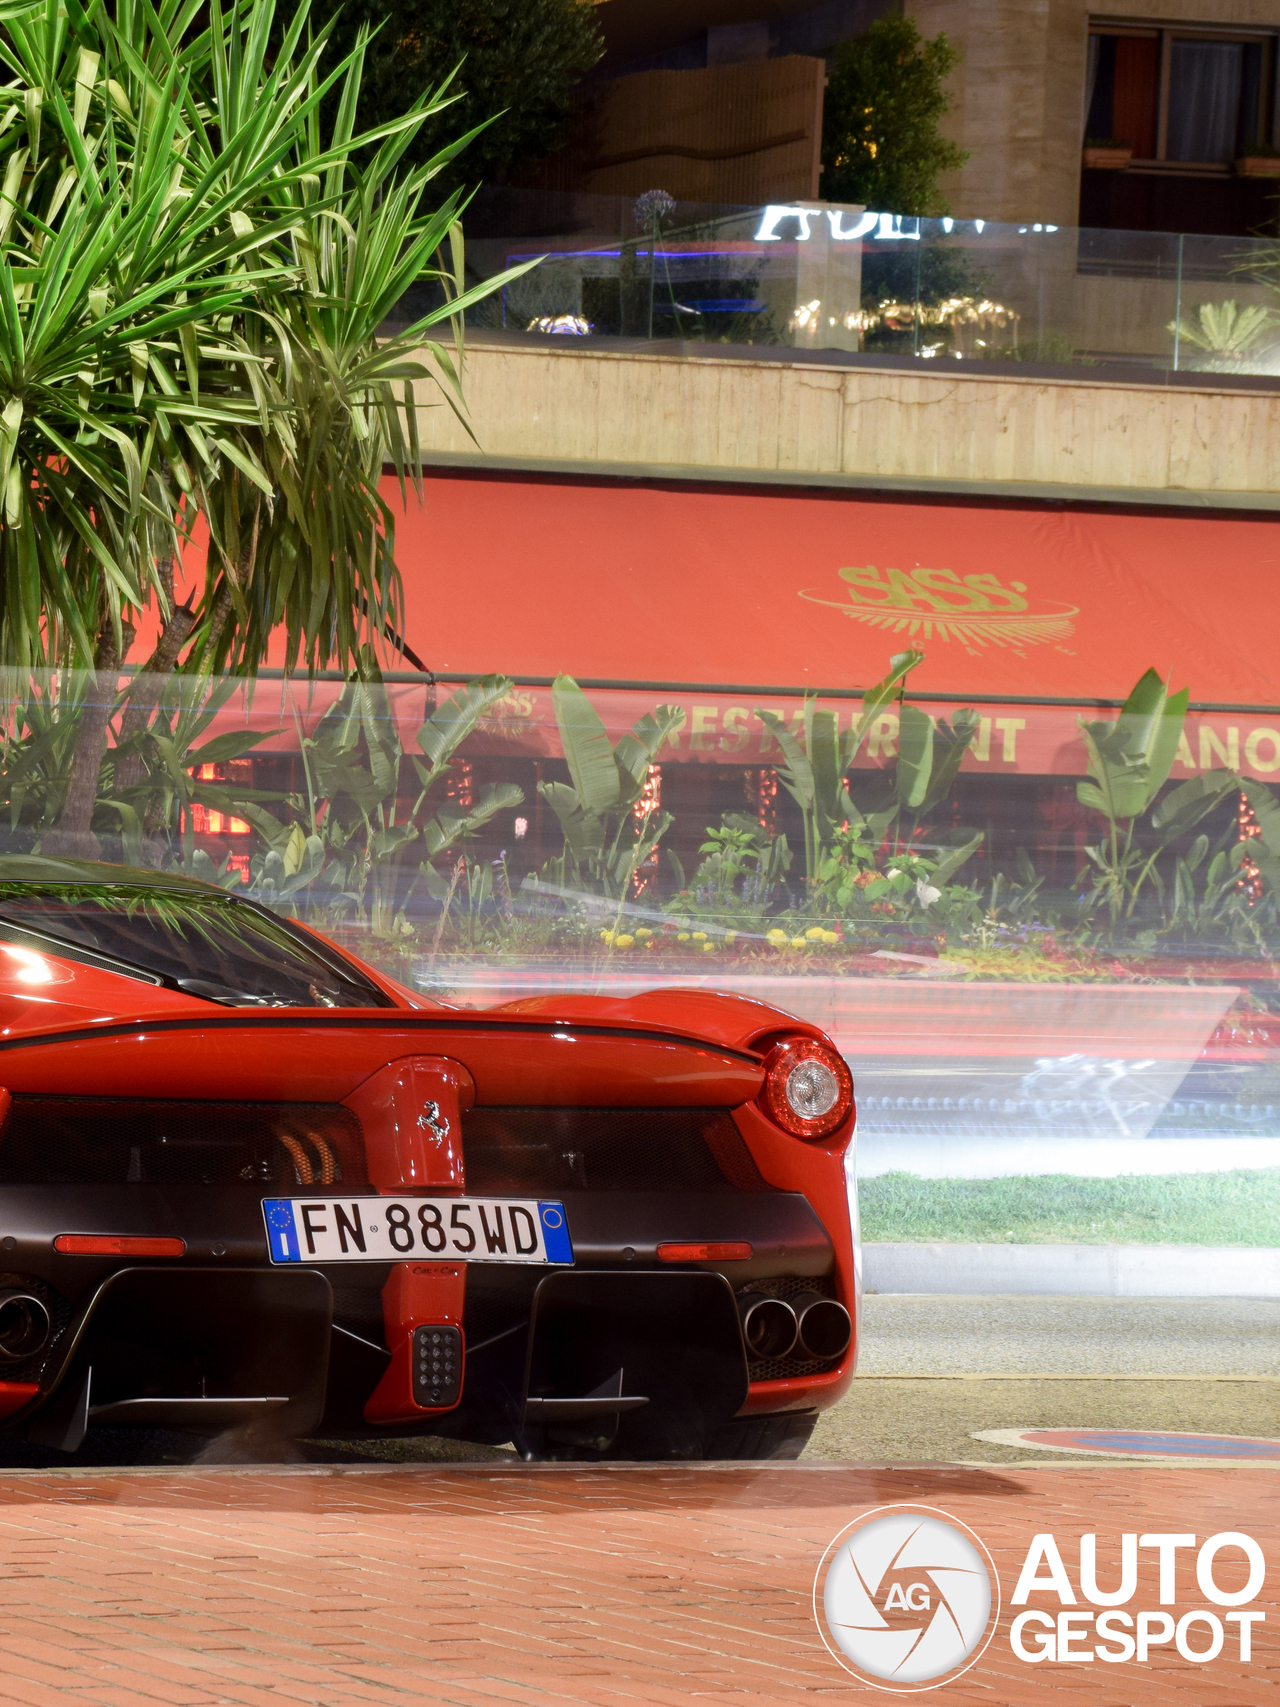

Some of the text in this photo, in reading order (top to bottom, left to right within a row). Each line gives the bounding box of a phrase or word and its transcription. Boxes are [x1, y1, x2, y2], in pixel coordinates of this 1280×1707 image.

[654, 703, 1280, 773] ESTRNT ANO
[300, 1203, 539, 1256] FN 885WD
